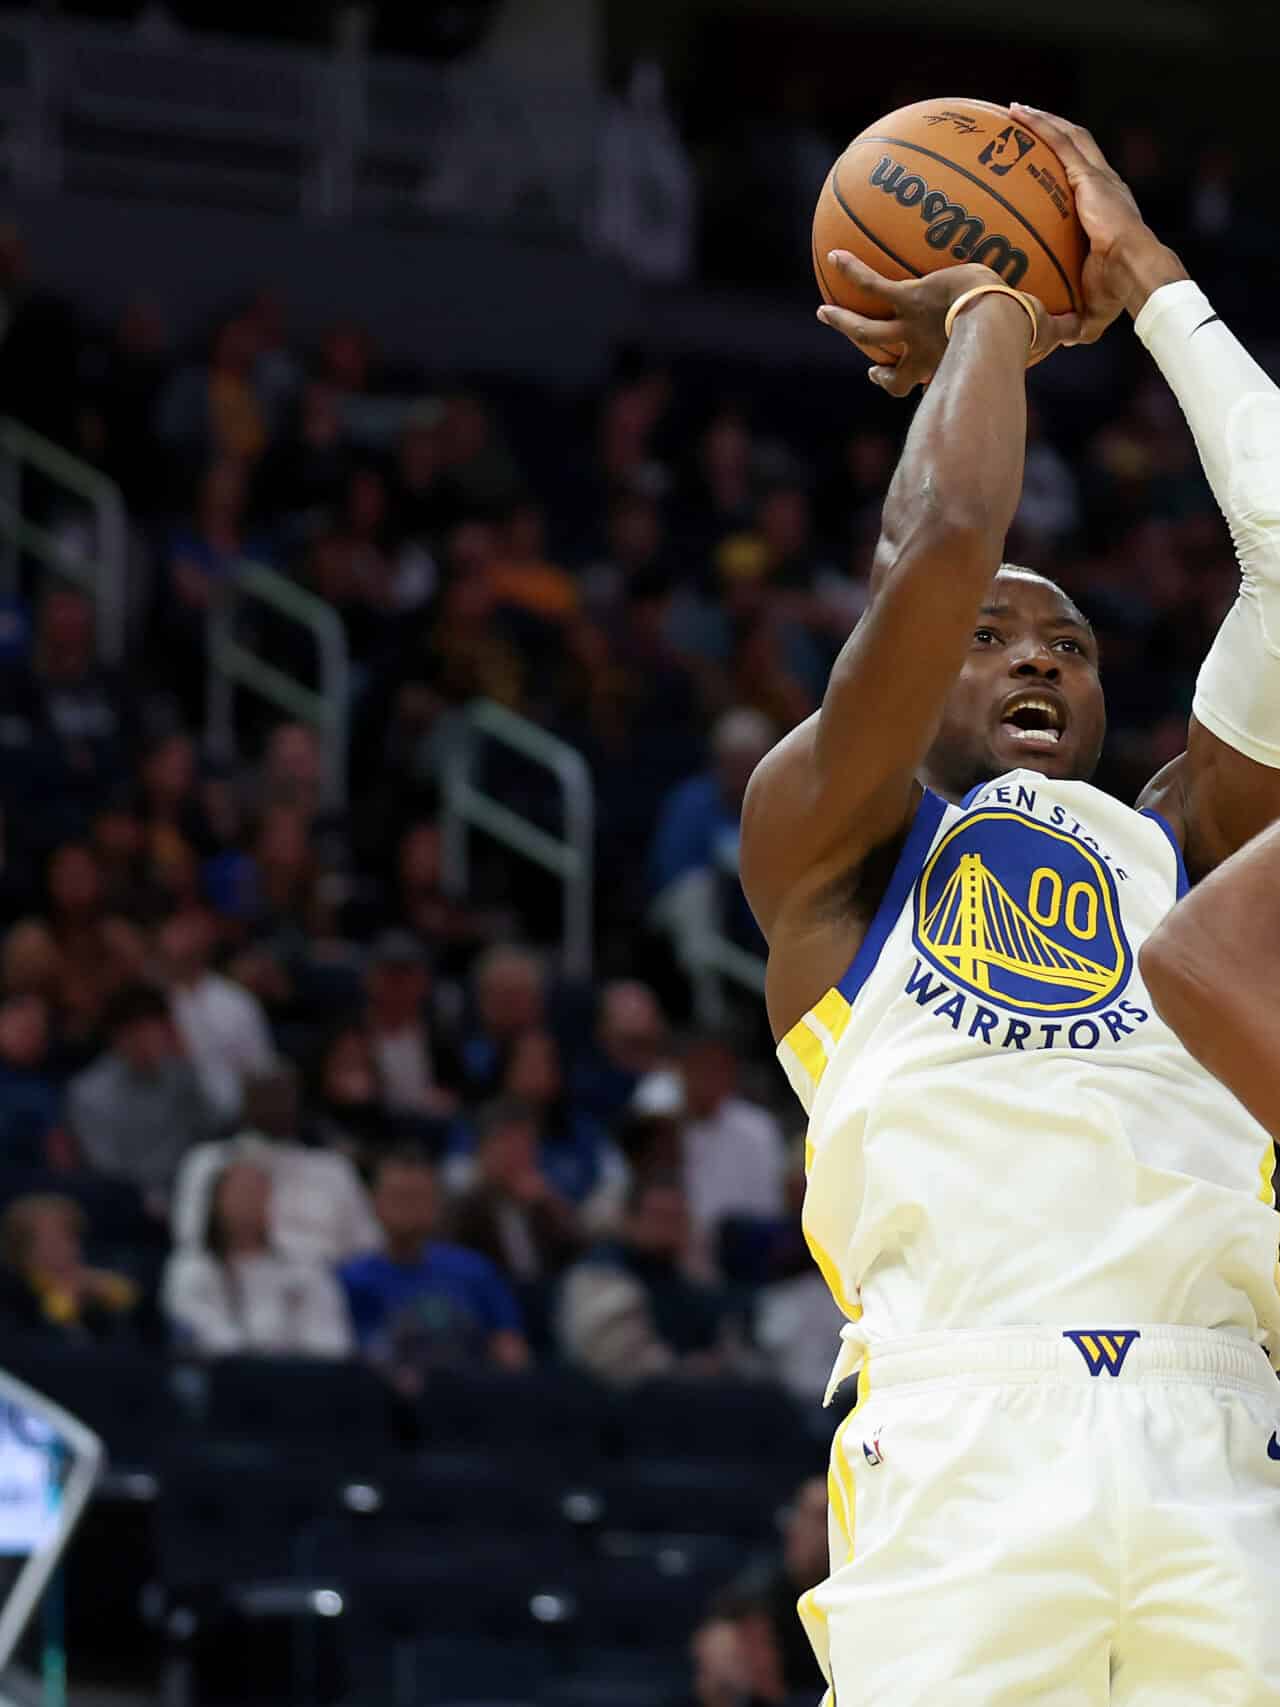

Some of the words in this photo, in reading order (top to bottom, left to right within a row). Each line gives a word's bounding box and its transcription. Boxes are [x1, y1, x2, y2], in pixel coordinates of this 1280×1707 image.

[868, 154, 1029, 289] Wilson
[1027, 866, 1098, 941] 00
[904, 958, 1149, 1051] WARRIORS
